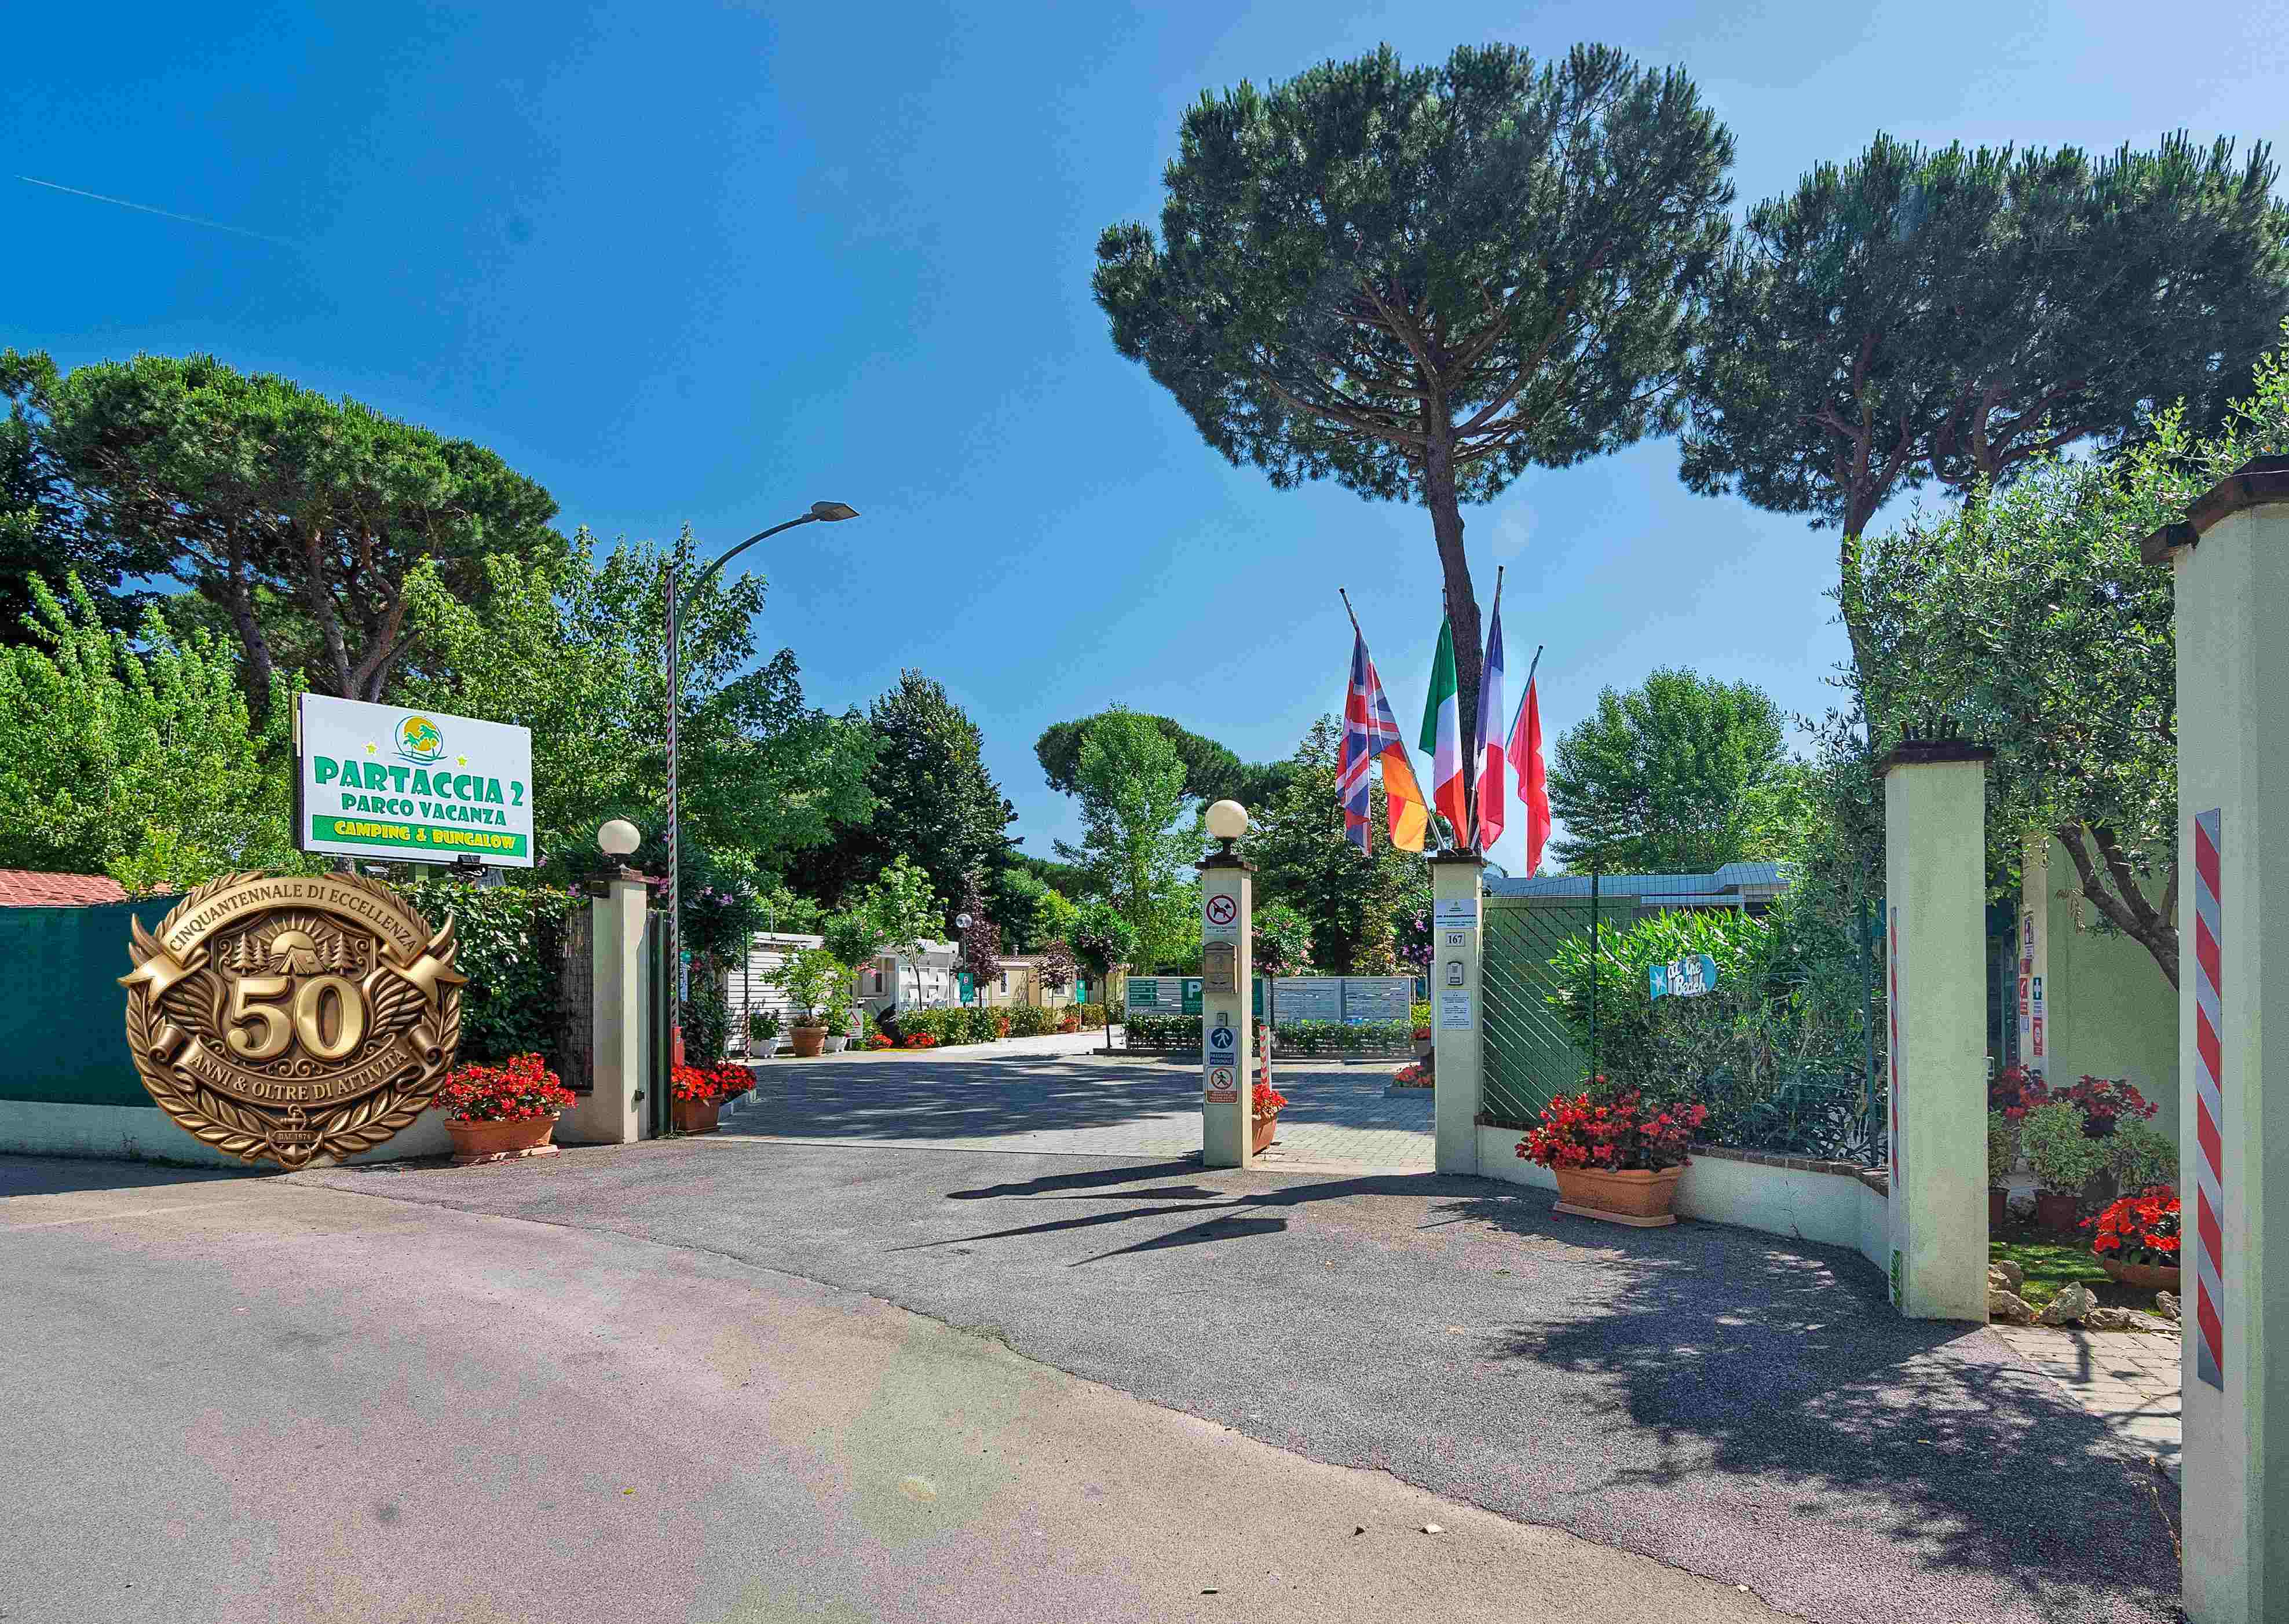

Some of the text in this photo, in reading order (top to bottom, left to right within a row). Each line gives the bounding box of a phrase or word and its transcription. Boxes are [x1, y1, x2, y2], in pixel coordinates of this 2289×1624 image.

[313, 755, 524, 807] PARTACCIA 2
[341, 792, 507, 826] PARCO VACANZA
[334, 820, 515, 850] CAMPING & BUNGALOW
[1449, 935, 1463, 944] 167
[1187, 981, 1202, 998] P
[1675, 975, 1707, 996] Beach
